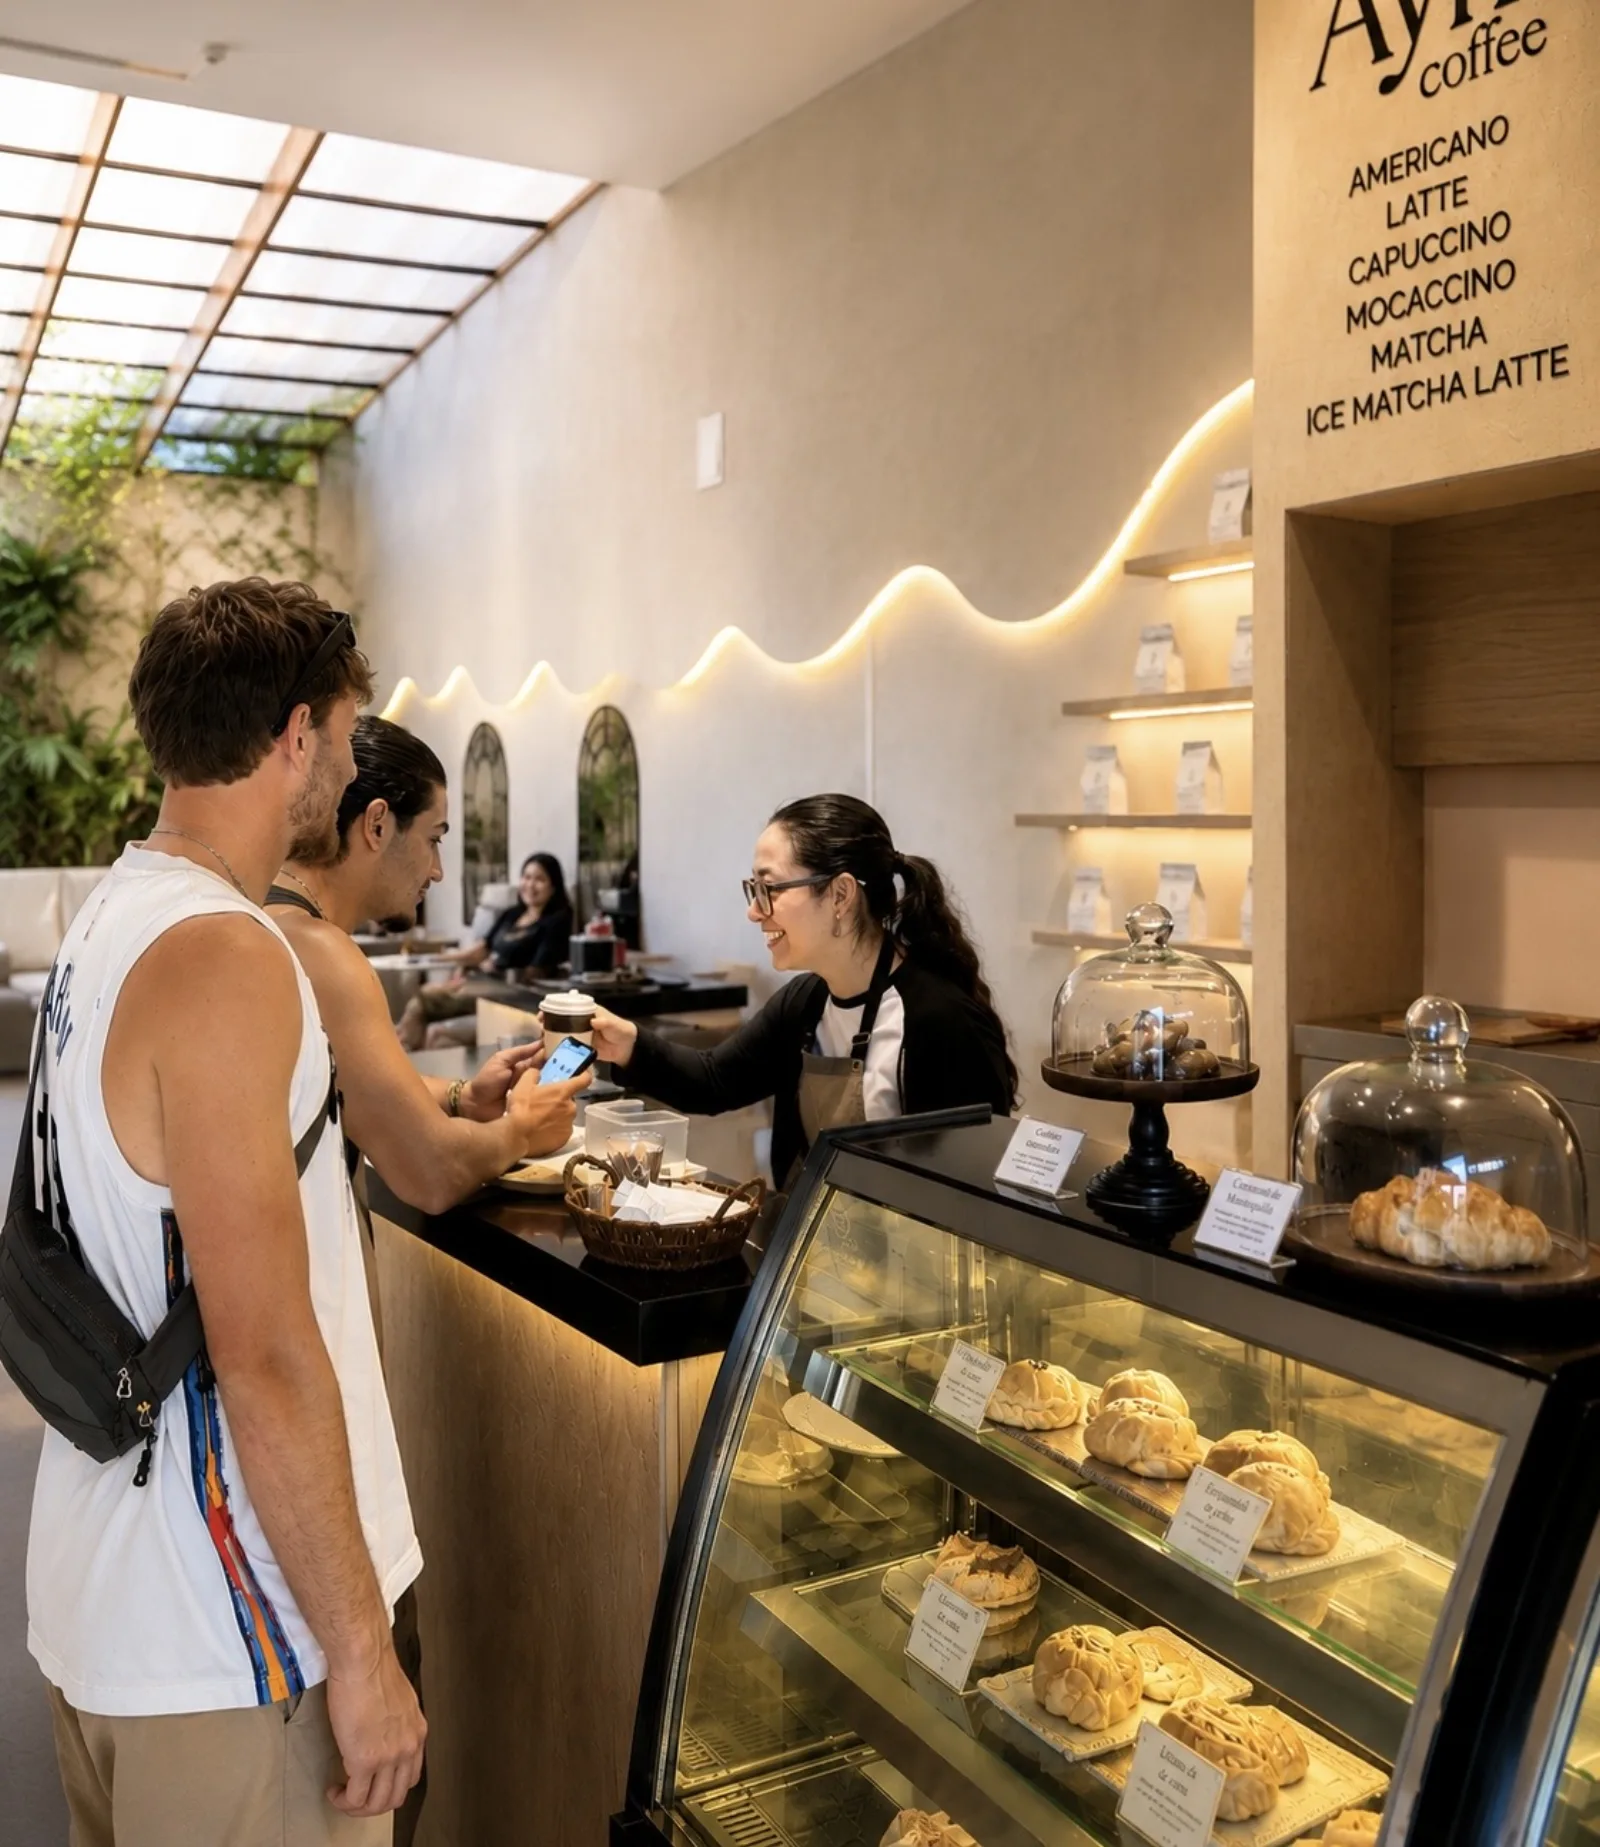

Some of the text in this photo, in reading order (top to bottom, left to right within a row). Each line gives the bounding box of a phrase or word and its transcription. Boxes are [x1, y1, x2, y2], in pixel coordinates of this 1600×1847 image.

[1419, 15, 1548, 99] coffee
[1348, 114, 1510, 198] AMERICANO
[1387, 175, 1469, 230] LATTE
[1348, 210, 1512, 285] CAPUCCINO
[1346, 258, 1517, 334] MOCACCINO
[1371, 315, 1488, 373] MATCHA
[1306, 343, 1570, 437] ICE MATCHA LATTE
